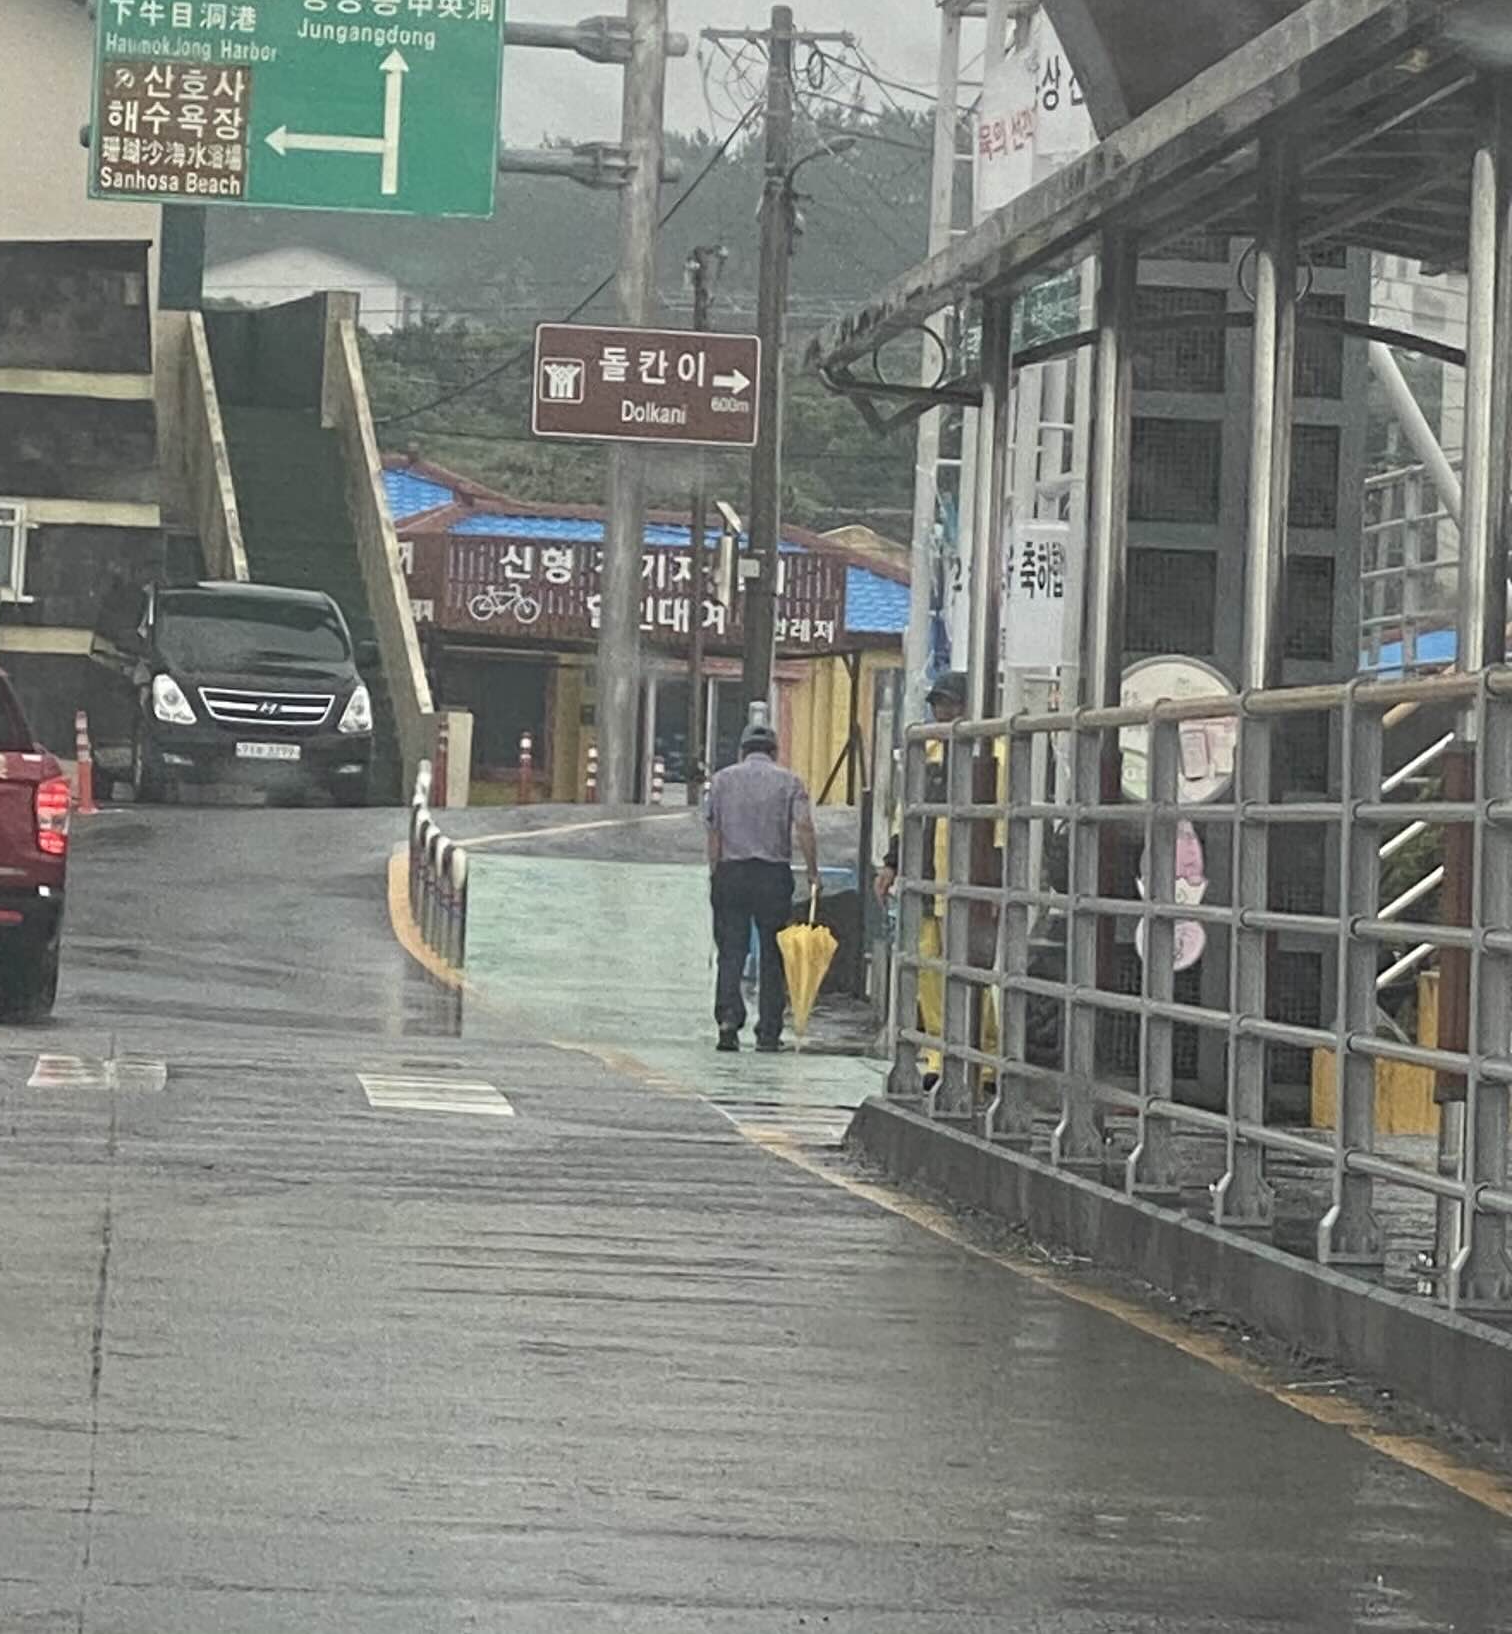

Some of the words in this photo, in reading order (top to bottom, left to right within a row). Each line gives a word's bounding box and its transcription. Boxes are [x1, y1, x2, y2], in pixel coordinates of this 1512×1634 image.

[109, 0, 257, 33] 下牛目洞港
[220, 38, 278, 62] Harbor
[297, 18, 437, 51] Jungangdong
[144, 64, 245, 102] 산호사
[108, 100, 242, 141] 해수욕장
[100, 166, 179, 192] Sanhosa
[186, 172, 240, 195] Beach
[599, 347, 706, 388] 돌칸이
[620, 400, 686, 425] Dolkani
[711, 397, 749, 413] 600m
[499, 544, 575, 585] 신형
